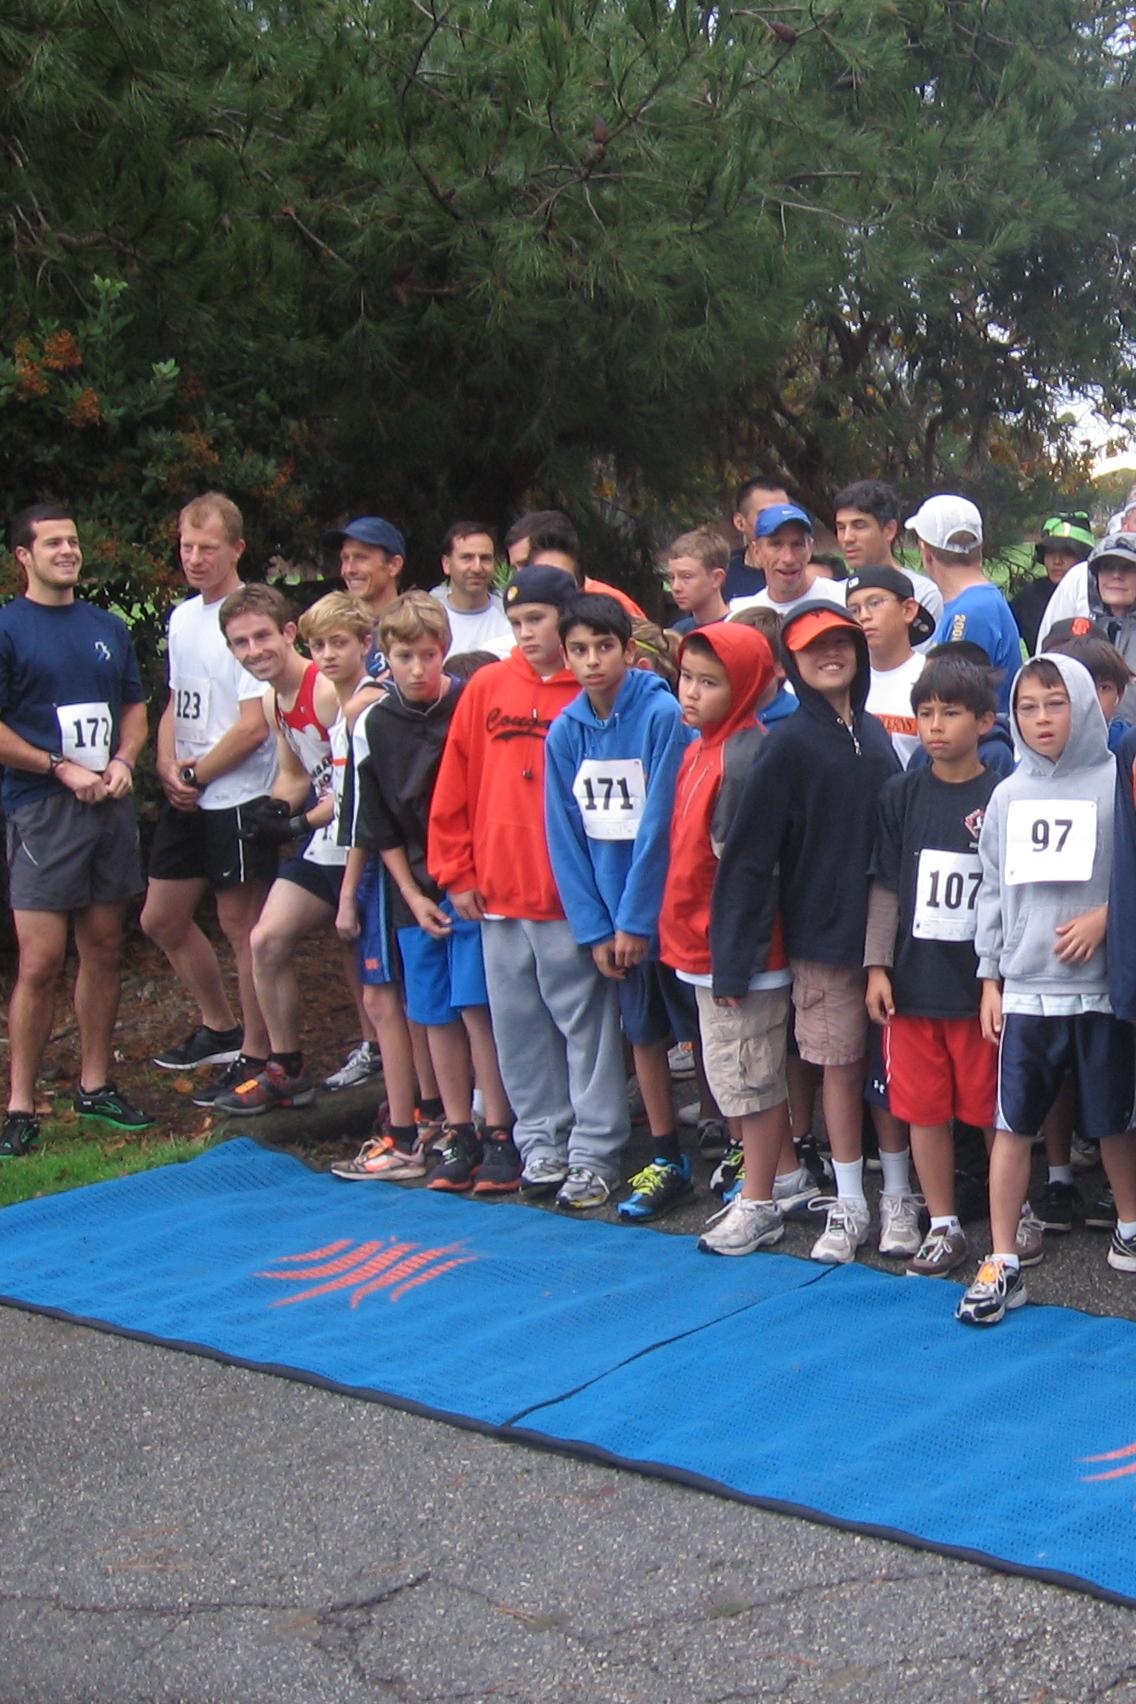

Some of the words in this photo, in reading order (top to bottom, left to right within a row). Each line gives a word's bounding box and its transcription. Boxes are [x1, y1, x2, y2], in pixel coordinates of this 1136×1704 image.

[176, 690, 201, 719] 123
[73, 718, 109, 748] 172
[582, 776, 633, 810] 171
[1031, 819, 1073, 852] 97
[926, 869, 984, 911] 107
